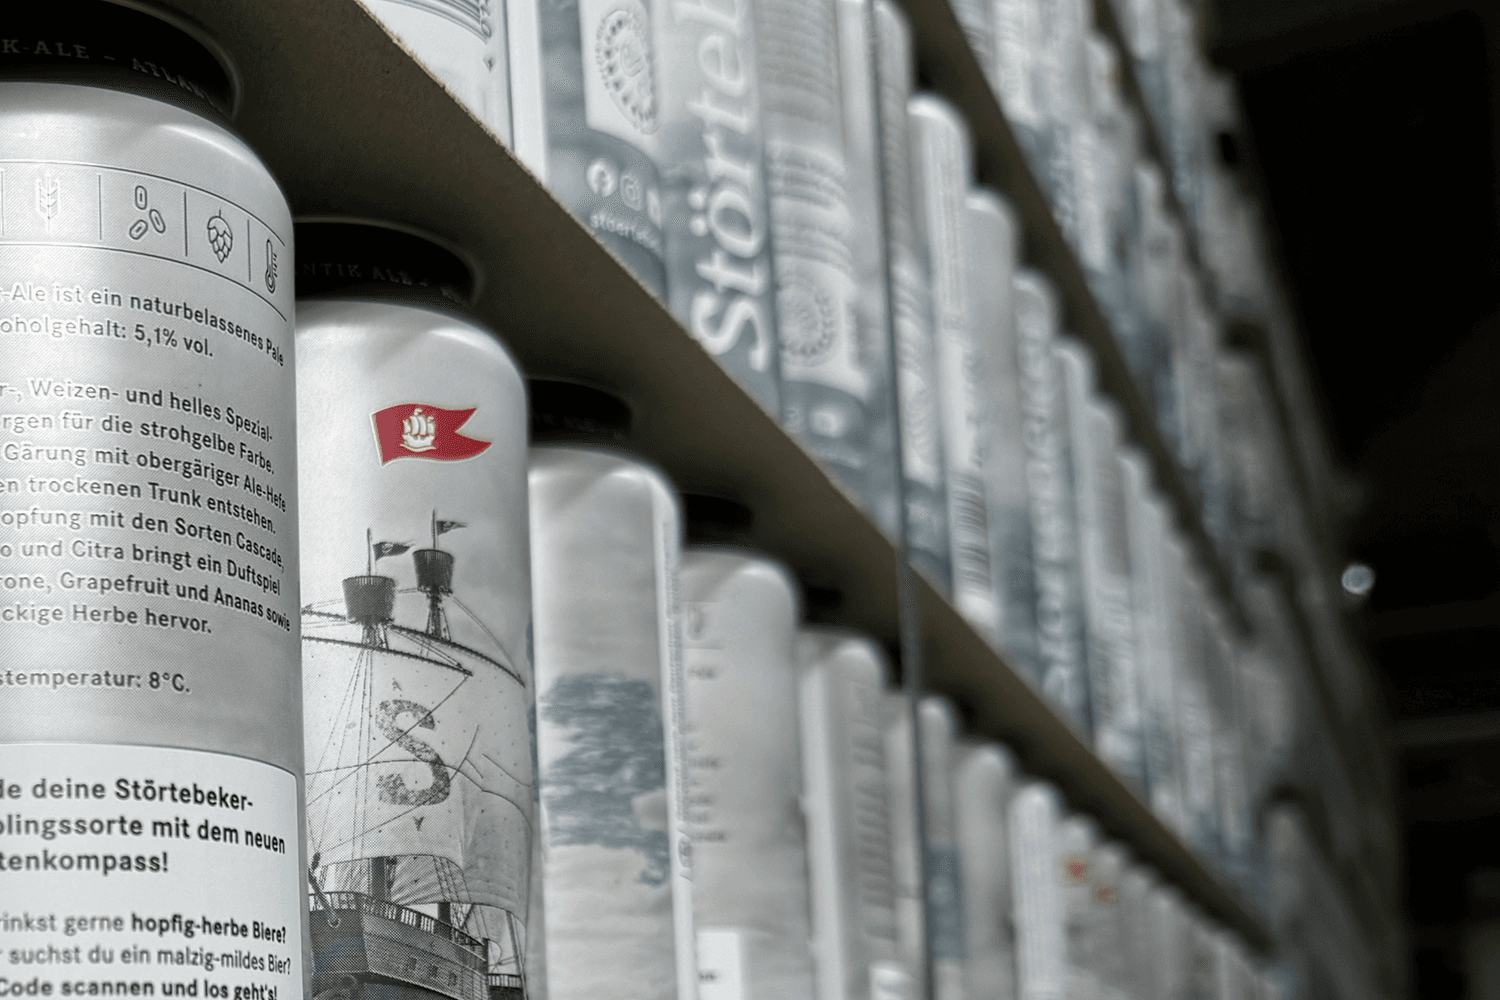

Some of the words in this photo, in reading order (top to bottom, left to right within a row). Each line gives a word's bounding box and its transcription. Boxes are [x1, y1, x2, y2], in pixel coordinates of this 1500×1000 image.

[55, 286, 81, 302] ist
[91, 288, 121, 305] ein
[130, 296, 263, 351] naturbelassenes
[266, 341, 284, 366] Pale
[134, 324, 178, 348] 5,1%
[183, 335, 213, 357] vol.
[31, 380, 119, 399] Weizen-
[126, 387, 162, 407] und
[170, 392, 221, 421] helles
[226, 408, 273, 442] Spezial-
[62, 412, 93, 430] für
[101, 415, 133, 434] die
[140, 421, 235, 457] strohgelbe
[239, 444, 275, 475] Farbe.
[4, 442, 86, 467] Gärung
[95, 447, 129, 466] mit
[136, 451, 239, 489] obergäriger
[243, 474, 286, 513] Ale-Hefe
[28, 476, 141, 499] trockenen
[148, 482, 201, 508] Trunk
[207, 497, 276, 535] entstehen.
[89, 509, 124, 529] mit
[132, 512, 168, 533] den
[175, 517, 231, 546] Sorten
[236, 532, 285, 572] Cascade,
[21, 540, 62, 558] und
[72, 540, 124, 559] Citra
[132, 544, 191, 571] bringt
[198, 553, 221, 574] ein
[227, 559, 280, 596] Duftspiel
[60, 572, 169, 596] Grapefruit
[176, 582, 208, 603] und
[214, 587, 263, 618] Ananas
[267, 607, 290, 632] sowie
[73, 605, 138, 624] Herbe
[145, 612, 211, 634] hervor.
[149, 672, 190, 693] 8°C.
[32, 778, 106, 799] deine
[115, 778, 253, 811] Störtebeker-
[152, 818, 190, 839] mit
[198, 820, 239, 844] dem
[245, 829, 285, 854] neuen
[64, 916, 124, 937] gerne
[131, 912, 248, 939] hopfig-herbe
[252, 921, 286, 943] Biere?
[9, 946, 81, 964] suchst
[88, 946, 114, 964] du
[121, 946, 150, 964] ein
[157, 946, 264, 972] malzig-mildes
[268, 955, 291, 976] Bier?
[61, 981, 155, 997] scannen
[162, 979, 198, 997] und
[204, 979, 229, 999] los
